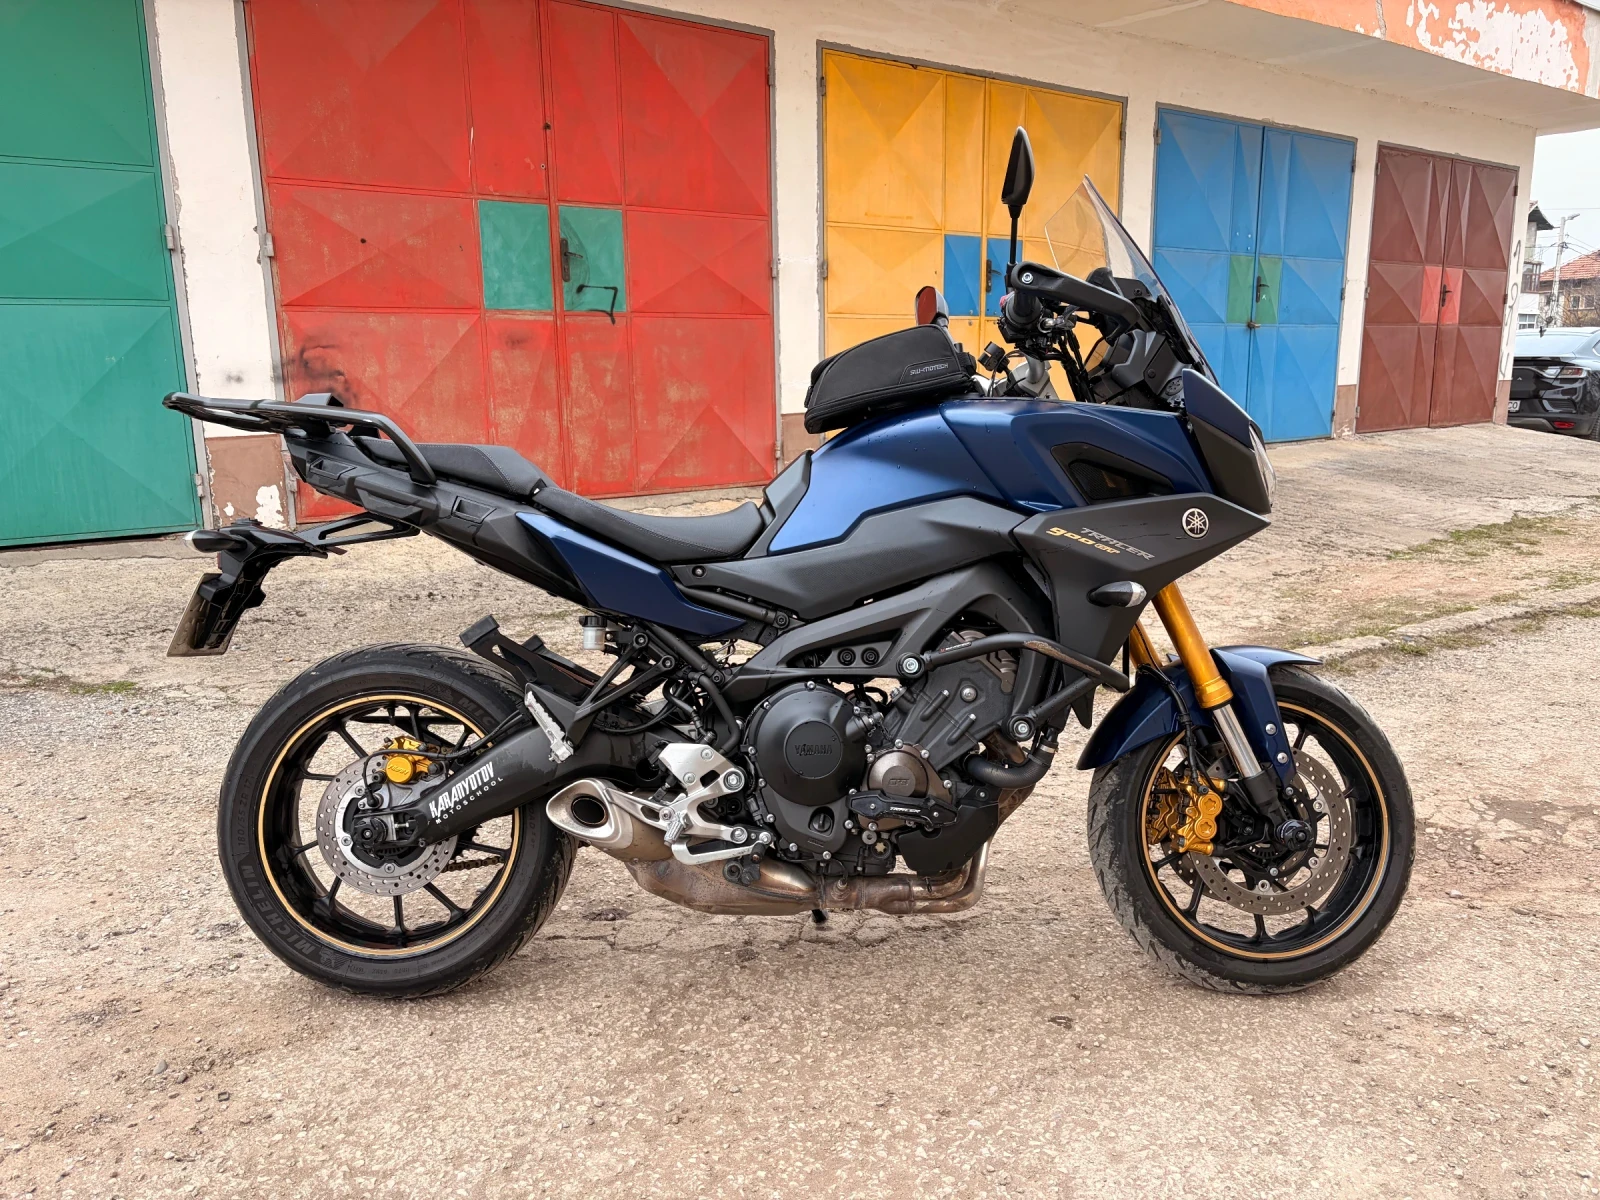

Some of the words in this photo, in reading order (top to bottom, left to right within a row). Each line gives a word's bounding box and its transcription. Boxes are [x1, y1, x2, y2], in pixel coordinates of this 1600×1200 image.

[1045, 526, 1095, 545] 900
[1094, 543, 1121, 554] GT
[1080, 527, 1155, 561] TRACER
[794, 744, 833, 756] YAMAHA
[241, 865, 316, 956] MICHELIN
